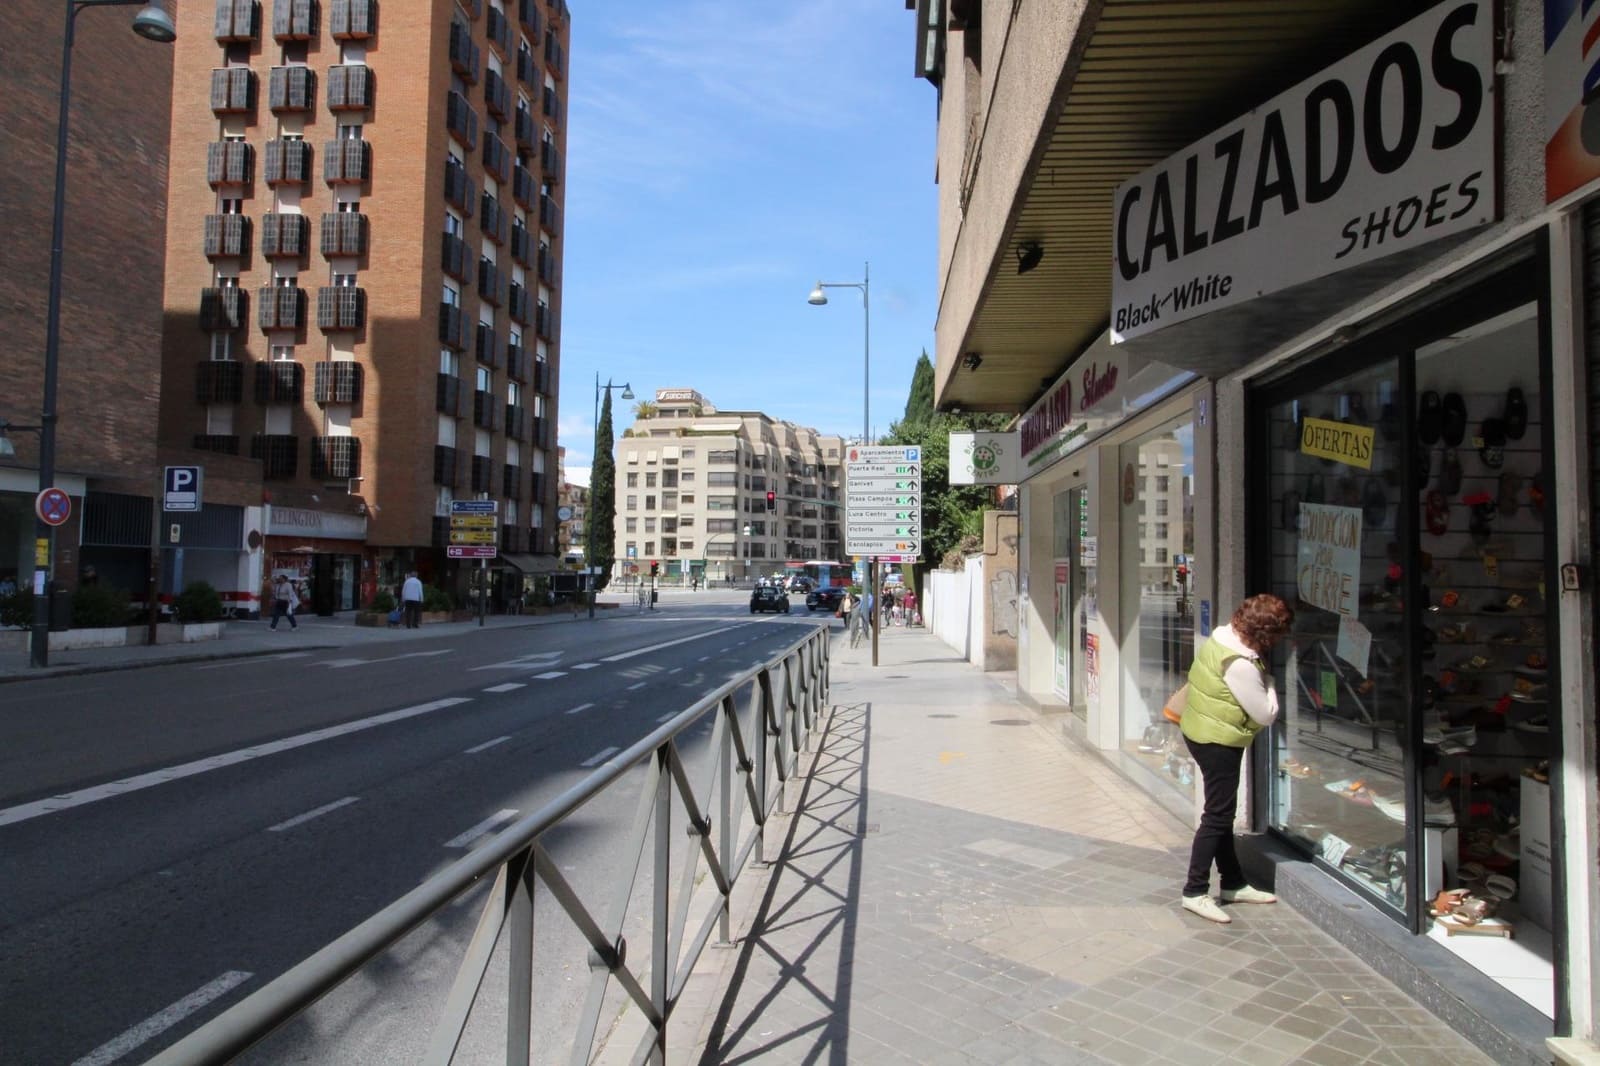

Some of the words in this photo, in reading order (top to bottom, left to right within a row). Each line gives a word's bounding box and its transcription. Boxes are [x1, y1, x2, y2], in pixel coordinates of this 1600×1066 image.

[1117, 3, 1484, 281] CALZADOS
[1335, 170, 1482, 259] SHOES
[1303, 425, 1370, 460] OFERTAS
[173, 469, 192, 491] P
